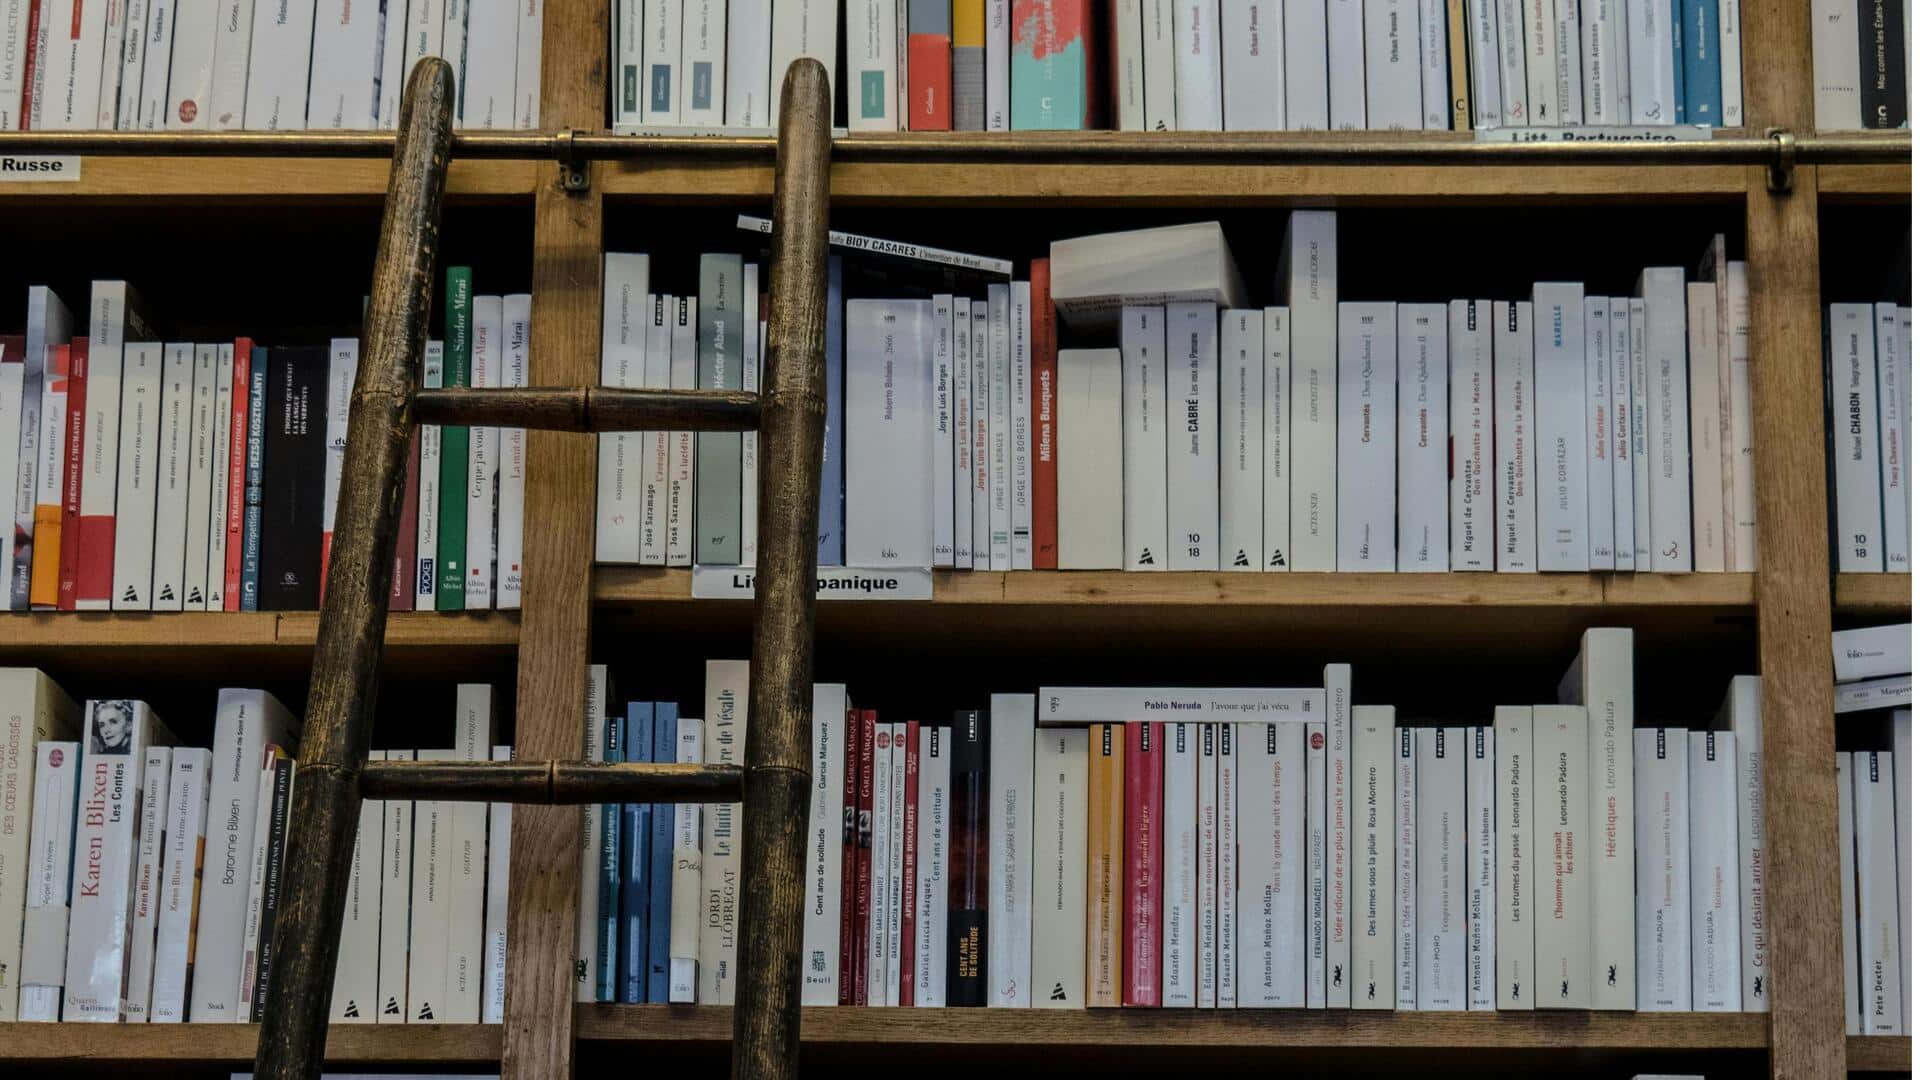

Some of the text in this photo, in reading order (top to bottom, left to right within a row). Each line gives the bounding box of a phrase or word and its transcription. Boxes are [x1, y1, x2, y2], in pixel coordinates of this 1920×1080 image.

[1876, 30, 1885, 88] Moi contre les
[2, 158, 64, 172] Russe
[846, 236, 917, 256] BIOY CASARES
[1552, 304, 1563, 347] MARELLE
[713, 320, 725, 388] Héctor Abad
[938, 364, 948, 433] Jorge Luis Borges
[1472, 372, 1480, 403] Manche
[249, 372, 263, 437] KOSZTOLÁNYI
[884, 389, 893, 420] Roberto
[1039, 370, 1052, 461] Milena Busquets
[1187, 399, 1198, 432] CABRÉ
[1850, 392, 1862, 434] CHABON
[1472, 419, 1481, 430] de
[232, 412, 243, 521] TRADUCTEUR CLEPTOMANE
[976, 419, 987, 491] Jorge Luis Borges
[1016, 416, 1025, 506] JORGE LUIS BORGES
[1473, 433, 1481, 477] Quichotte
[1617, 440, 1628, 460] Julio
[248, 470, 260, 504] tchèque
[680, 470, 688, 480] La
[1473, 480, 1481, 495] Don
[670, 480, 680, 546] José Saramago
[1464, 460, 1474, 551] Miguel de Cervantes
[1560, 486, 1568, 510] JULIO
[246, 506, 259, 559] Trompettiste
[1188, 534, 1200, 543] 10
[1854, 534, 1866, 543] 10
[246, 561, 255, 572] Le
[882, 549, 898, 559] folio
[1188, 548, 1200, 557] 18
[1856, 548, 1866, 558] 18
[17, 565, 27, 594] Fayard
[718, 690, 735, 726] Vésale
[1144, 700, 1202, 710] Pablo Neruda
[1333, 688, 1344, 728] Montero
[1605, 702, 1616, 737] Padura
[717, 730, 733, 744] de
[1333, 730, 1344, 751] Rosa
[1333, 759, 1344, 784] revoir
[1511, 755, 1520, 785] Padura
[1605, 740, 1616, 789] Leonardo
[1746, 752, 1759, 788] Padura
[110, 763, 125, 822] Les Contes
[1335, 788, 1343, 798] te
[1368, 767, 1376, 805] Montero
[1558, 752, 1568, 825] Leonardo Padura
[714, 803, 733, 837] Huiti
[1333, 799, 1345, 829] jamais
[1368, 808, 1376, 828] Rosa
[1511, 787, 1520, 828] Leonardo
[1749, 791, 1760, 840] Leonardo
[4, 814, 15, 835] DES
[81, 763, 108, 897] Karen Blixen
[931, 787, 942, 881] Cent ans de solitude
[1334, 832, 1345, 850] plus
[223, 799, 240, 885] Baronne Blixen
[714, 841, 730, 856] Le
[1335, 853, 1344, 864] ne
[1368, 834, 1378, 855] pluie
[1564, 832, 1574, 874] les chiens
[815, 829, 825, 915] Cent ans de solitude
[1334, 870, 1343, 882] de
[1367, 856, 1376, 865] la
[1511, 863, 1520, 874] du
[1553, 831, 1565, 920] L'homme qui aimait
[1750, 848, 1761, 884] arriver
[139, 864, 152, 917] Karen Blixen
[1334, 885, 1344, 914] ridicule
[1368, 889, 1376, 918] larmes
[1511, 877, 1520, 906] brumes
[709, 889, 721, 928] JORDI
[721, 870, 735, 948] LLOBREGAT
[1512, 909, 1520, 922] Les
[1263, 885, 1272, 987] Antonio Muñoz Molina
[1368, 921, 1376, 936] Des
[1751, 933, 1764, 949] qui
[959, 937, 969, 977] CENT ANS
[969, 927, 979, 977] DE SOLITUDE
[1203, 909, 1213, 989] Eduardo Mendoza
[1752, 953, 1763, 967] Ce
[807, 976, 830, 984] Seuil
[1874, 961, 1883, 1015] Pete Dexter
